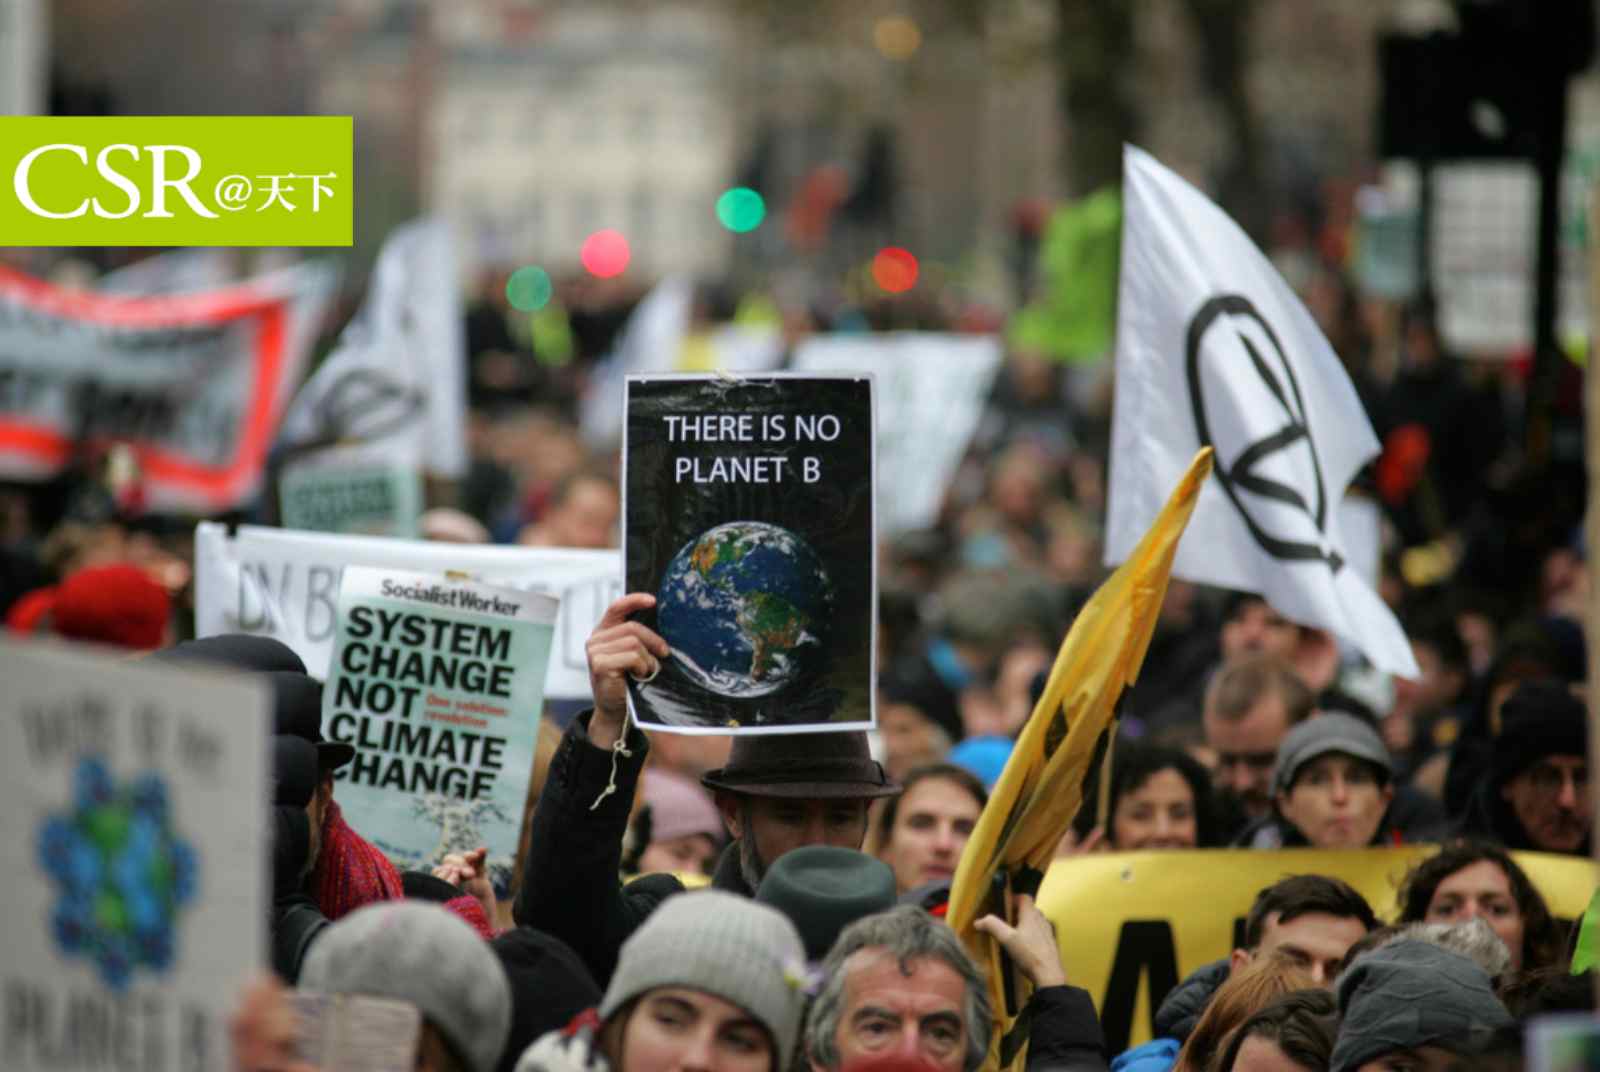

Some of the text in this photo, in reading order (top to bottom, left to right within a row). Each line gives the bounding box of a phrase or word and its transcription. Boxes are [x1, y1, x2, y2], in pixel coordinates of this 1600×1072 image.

[662, 414, 841, 442] THERE IS NO
[675, 456, 821, 483] PLANET B
[346, 606, 512, 661] SYSTEM
[341, 642, 514, 697] CHANGE
[334, 677, 421, 718] NOT
[329, 713, 507, 771] CLIMATE
